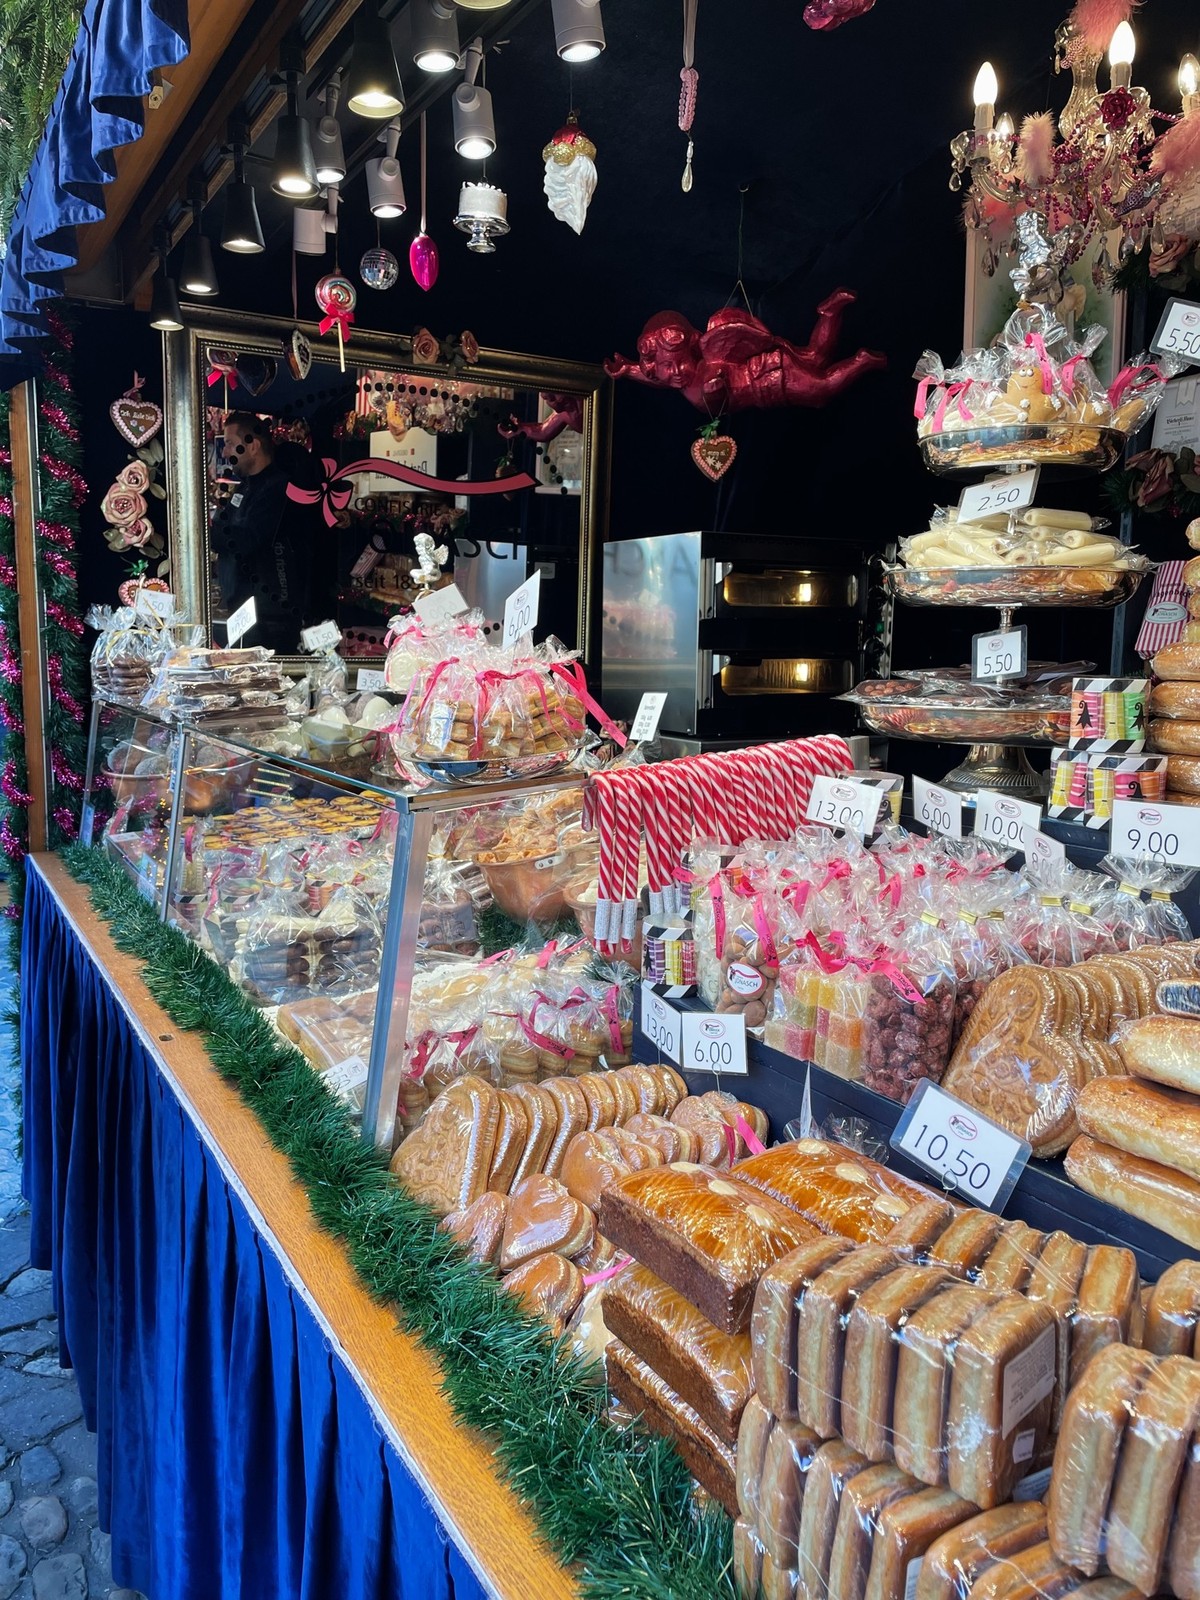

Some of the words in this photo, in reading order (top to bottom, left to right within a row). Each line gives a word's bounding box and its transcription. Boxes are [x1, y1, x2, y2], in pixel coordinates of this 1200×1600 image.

[1165, 327, 1200, 355] 5.50
[977, 487, 1020, 512] 2.50
[355, 572, 386, 590] seit
[508, 604, 531, 638] 6.00
[983, 652, 1013, 675] 5.50
[815, 800, 864, 828] 13.00
[921, 802, 951, 830] 6.00
[1127, 828, 1179, 856] 9.00
[646, 1013, 674, 1052] 13.00
[694, 1040, 732, 1065] 6.00
[914, 1124, 991, 1189] 10.50
